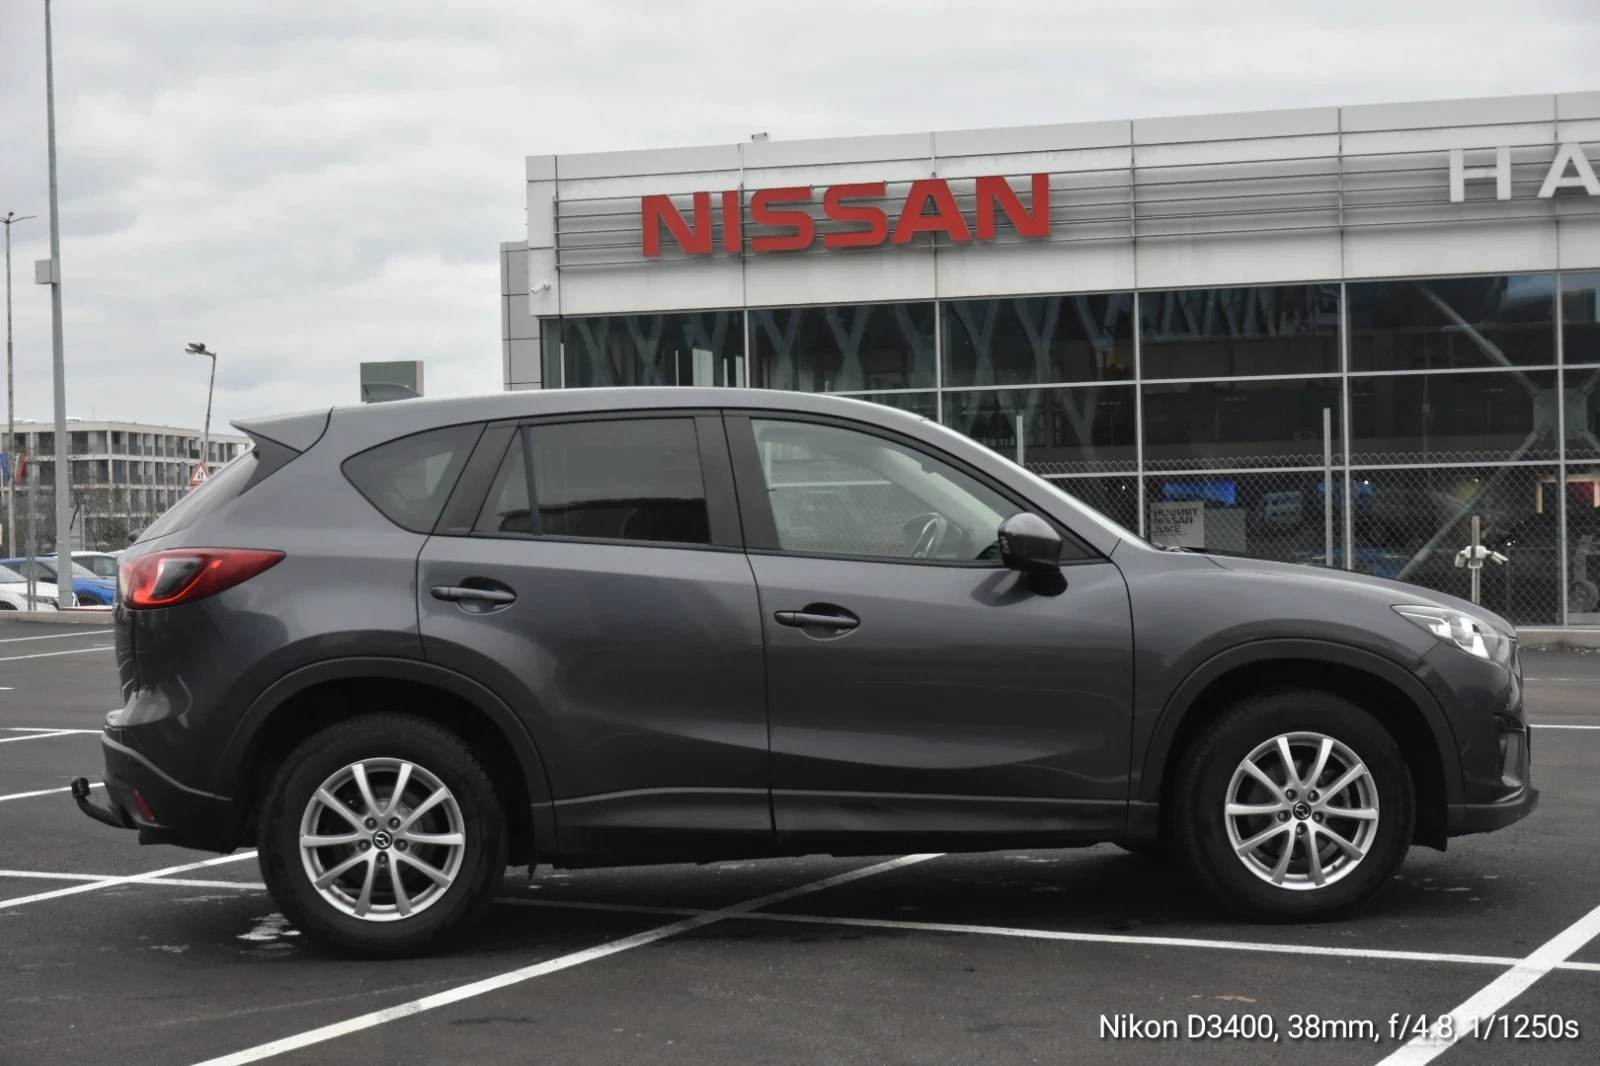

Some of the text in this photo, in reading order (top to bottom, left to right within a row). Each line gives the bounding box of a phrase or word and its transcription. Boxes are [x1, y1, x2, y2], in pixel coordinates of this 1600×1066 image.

[1449, 142, 1600, 203] HA
[641, 173, 1051, 257] NISSAN
[1153, 525, 1180, 533] JUKE
[1154, 516, 1192, 524] NISSAN
